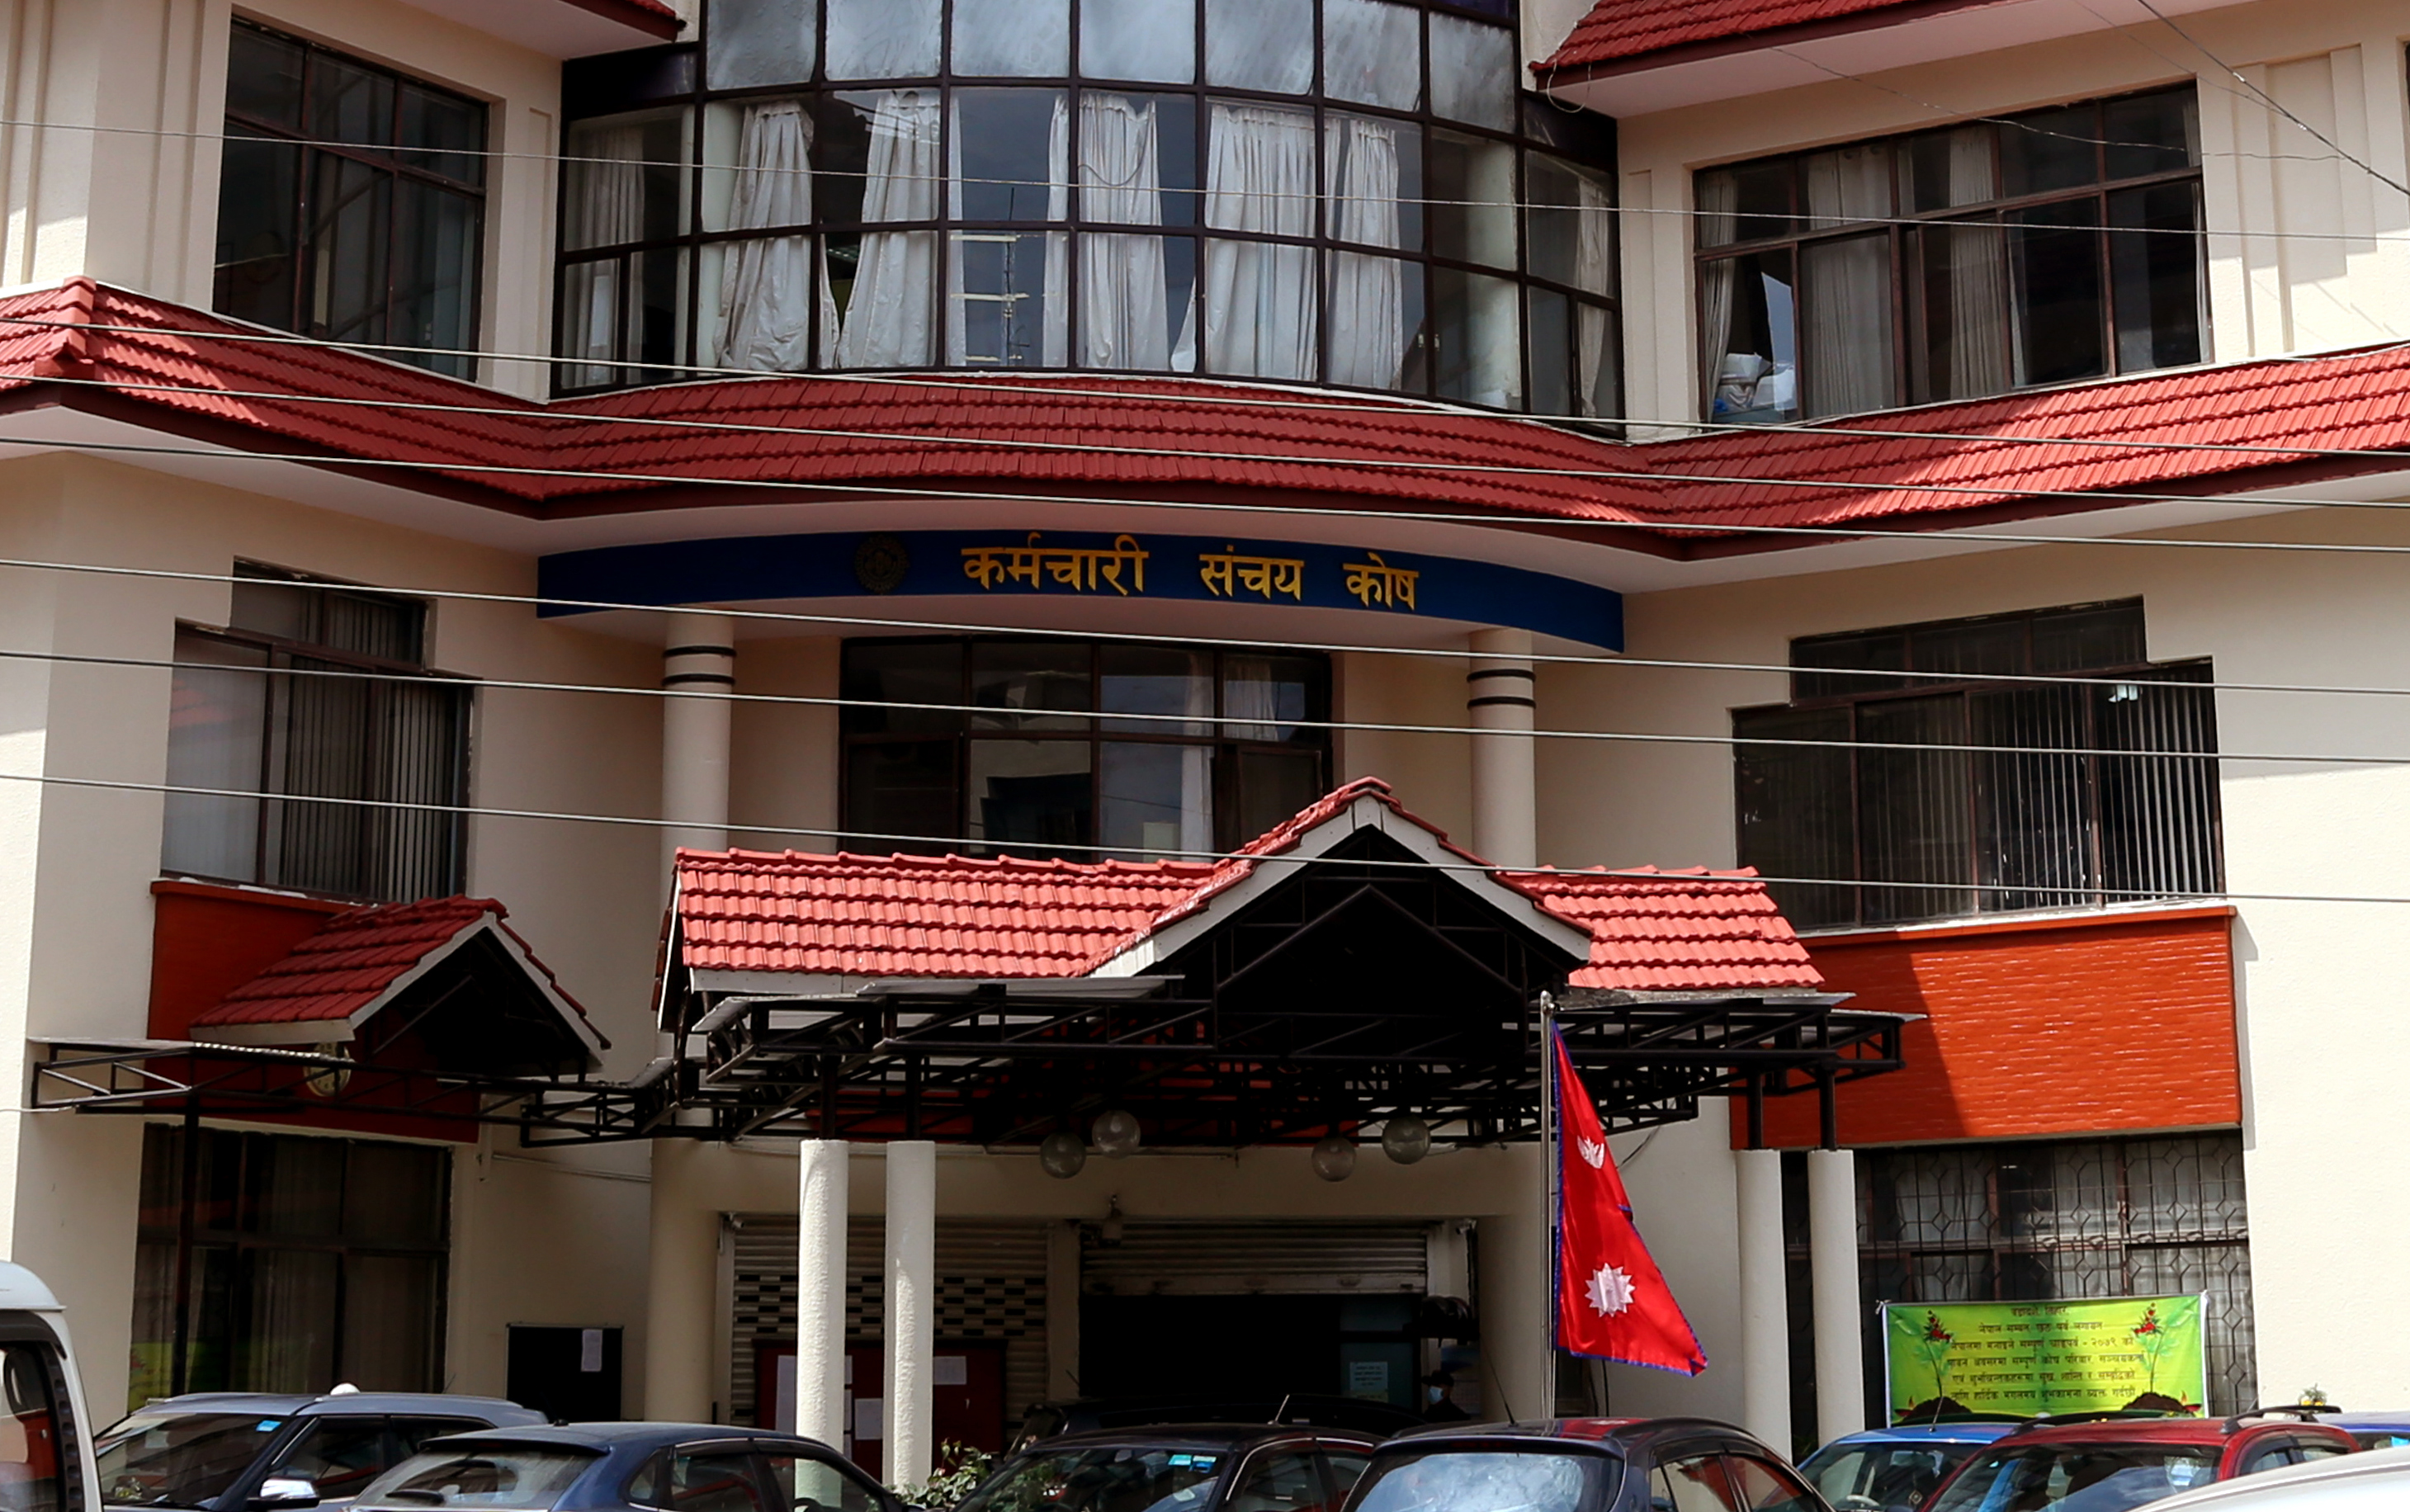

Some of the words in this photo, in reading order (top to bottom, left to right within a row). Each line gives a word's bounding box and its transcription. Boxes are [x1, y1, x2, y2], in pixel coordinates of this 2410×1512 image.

[960, 533, 1151, 597] कर्मचारी
[1198, 545, 1306, 601] संचय
[1342, 553, 1420, 610] कोष
